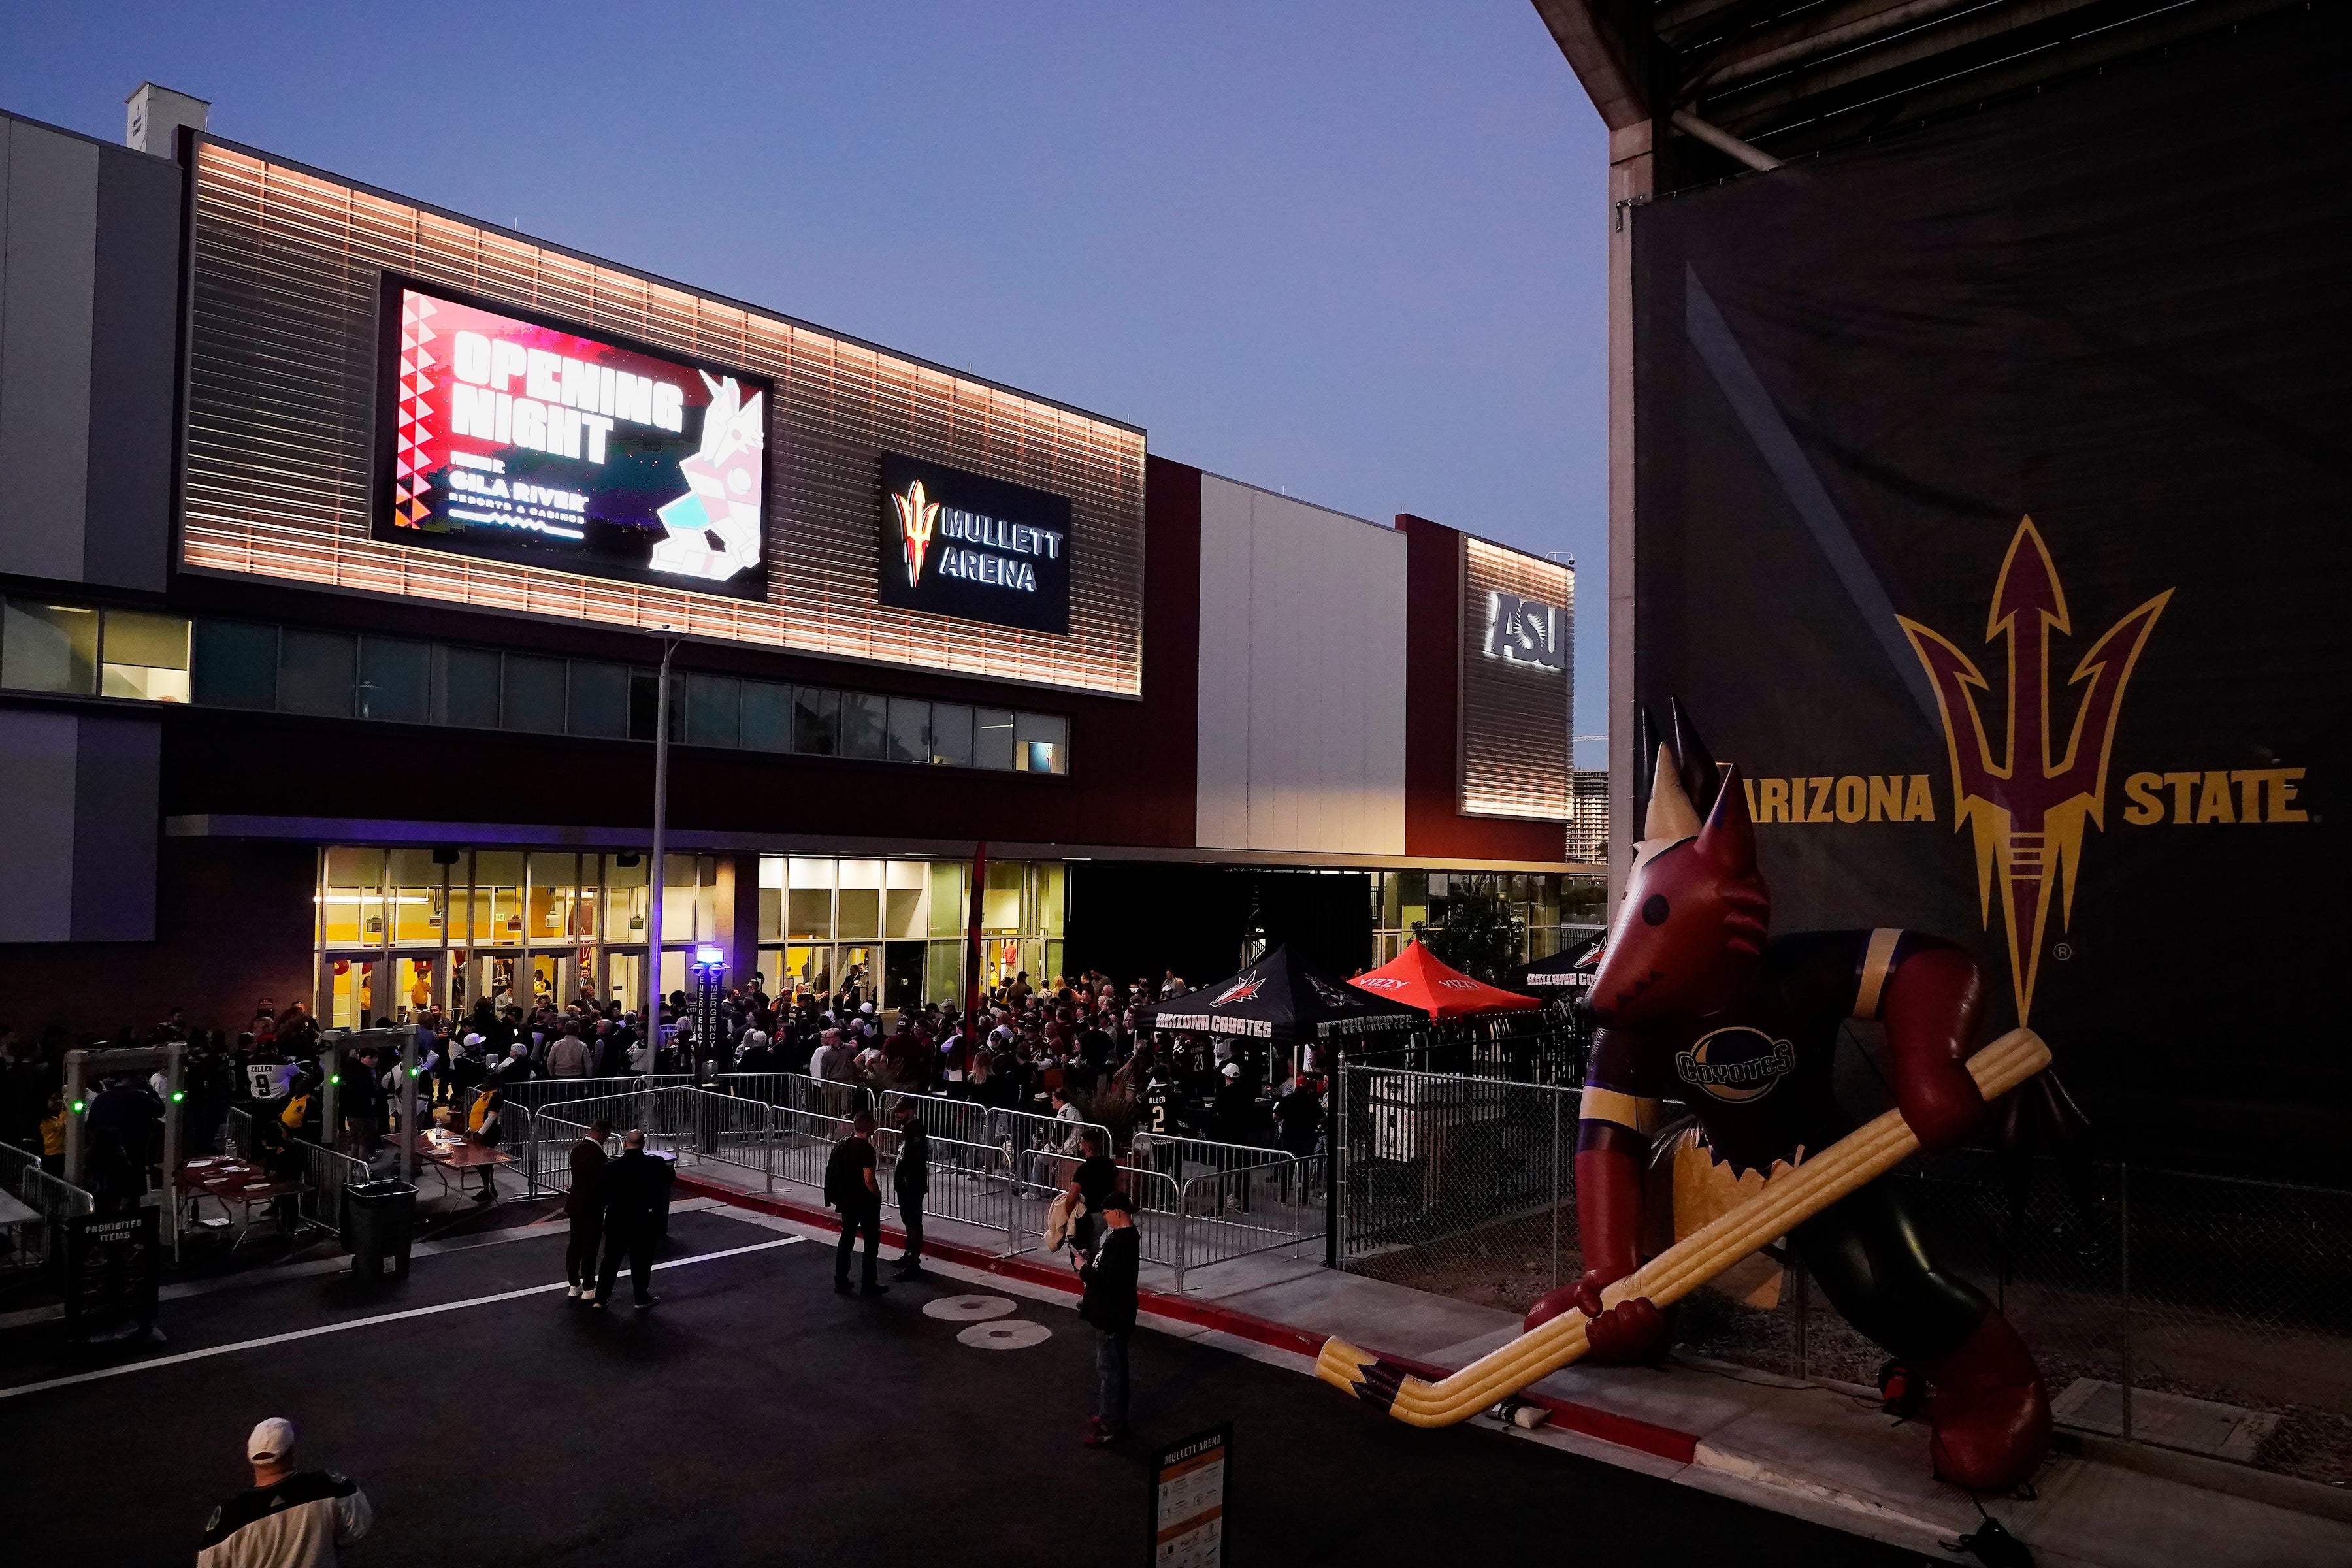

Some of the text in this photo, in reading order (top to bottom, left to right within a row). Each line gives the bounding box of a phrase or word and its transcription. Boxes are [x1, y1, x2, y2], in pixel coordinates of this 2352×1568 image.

[454, 331, 683, 432] OPENING
[452, 382, 613, 464] NIGHT
[449, 470, 584, 513] GILA RIVER
[449, 493, 512, 511] RESORTS
[529, 508, 585, 525] CASINOS
[941, 507, 1063, 559] MULLETT
[939, 546, 1037, 591] ARENA
[1487, 593, 1566, 669] ASU
[2123, 767, 2311, 825] STATE
[1360, 978, 1410, 988] VIZZY
[1439, 979, 1480, 988] VIZZY
[1527, 973, 1577, 985] ARIZONA
[709, 977, 718, 1048] EMERGENCY
[1156, 1013, 1272, 1038] ARIZONA COYOTES
[1194, 1053, 1203, 1071] 23
[1680, 1043, 1792, 1083] COYOTES
[255, 1074, 271, 1097] 9
[1152, 1105, 1164, 1132] 2
[85, 1219, 142, 1233] PROHIBITED
[100, 1232, 131, 1242] ITEMS
[1164, 1444, 1197, 1465] MULLETT
[1199, 1435, 1221, 1452] ARENA
